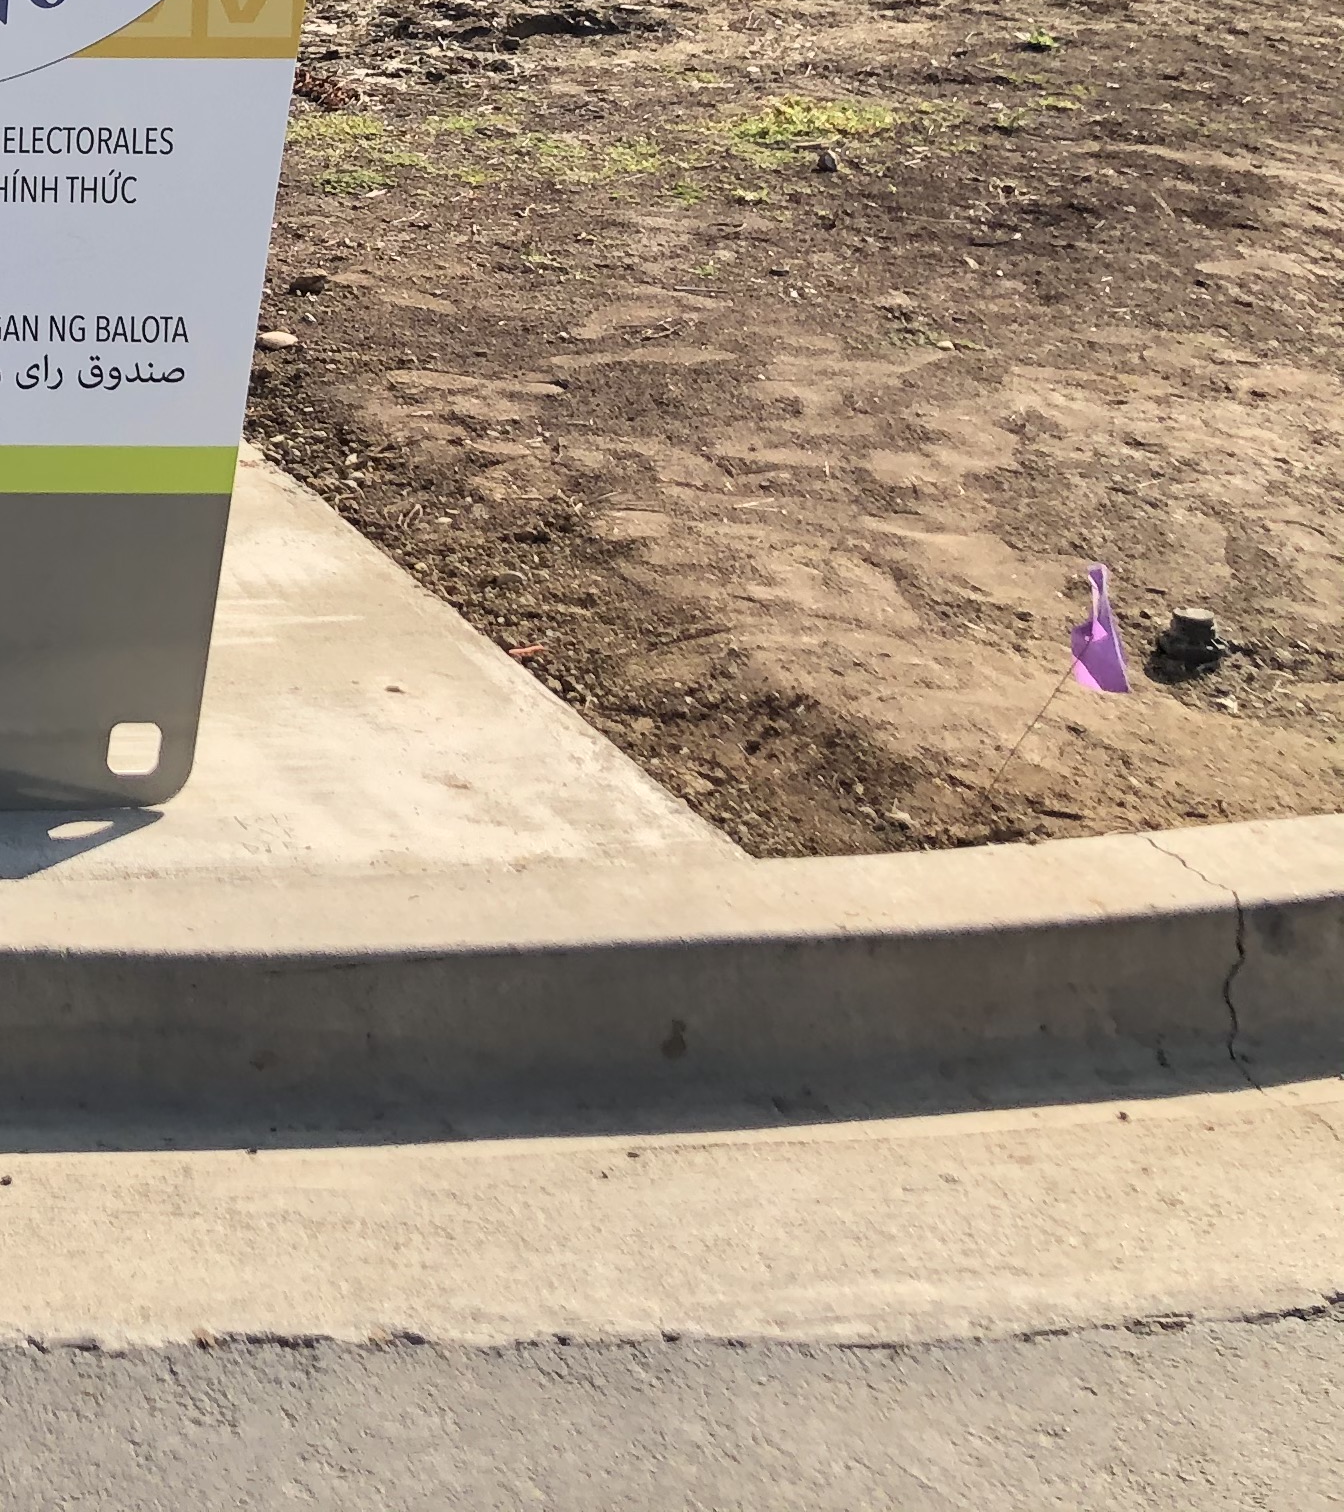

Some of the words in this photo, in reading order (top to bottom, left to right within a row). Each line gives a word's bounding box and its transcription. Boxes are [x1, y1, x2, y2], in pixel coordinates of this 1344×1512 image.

[4, 127, 174, 155] ELECTORALES
[66, 169, 137, 204] THỨC
[49, 315, 86, 343] NG
[96, 316, 189, 344] BALOTA
